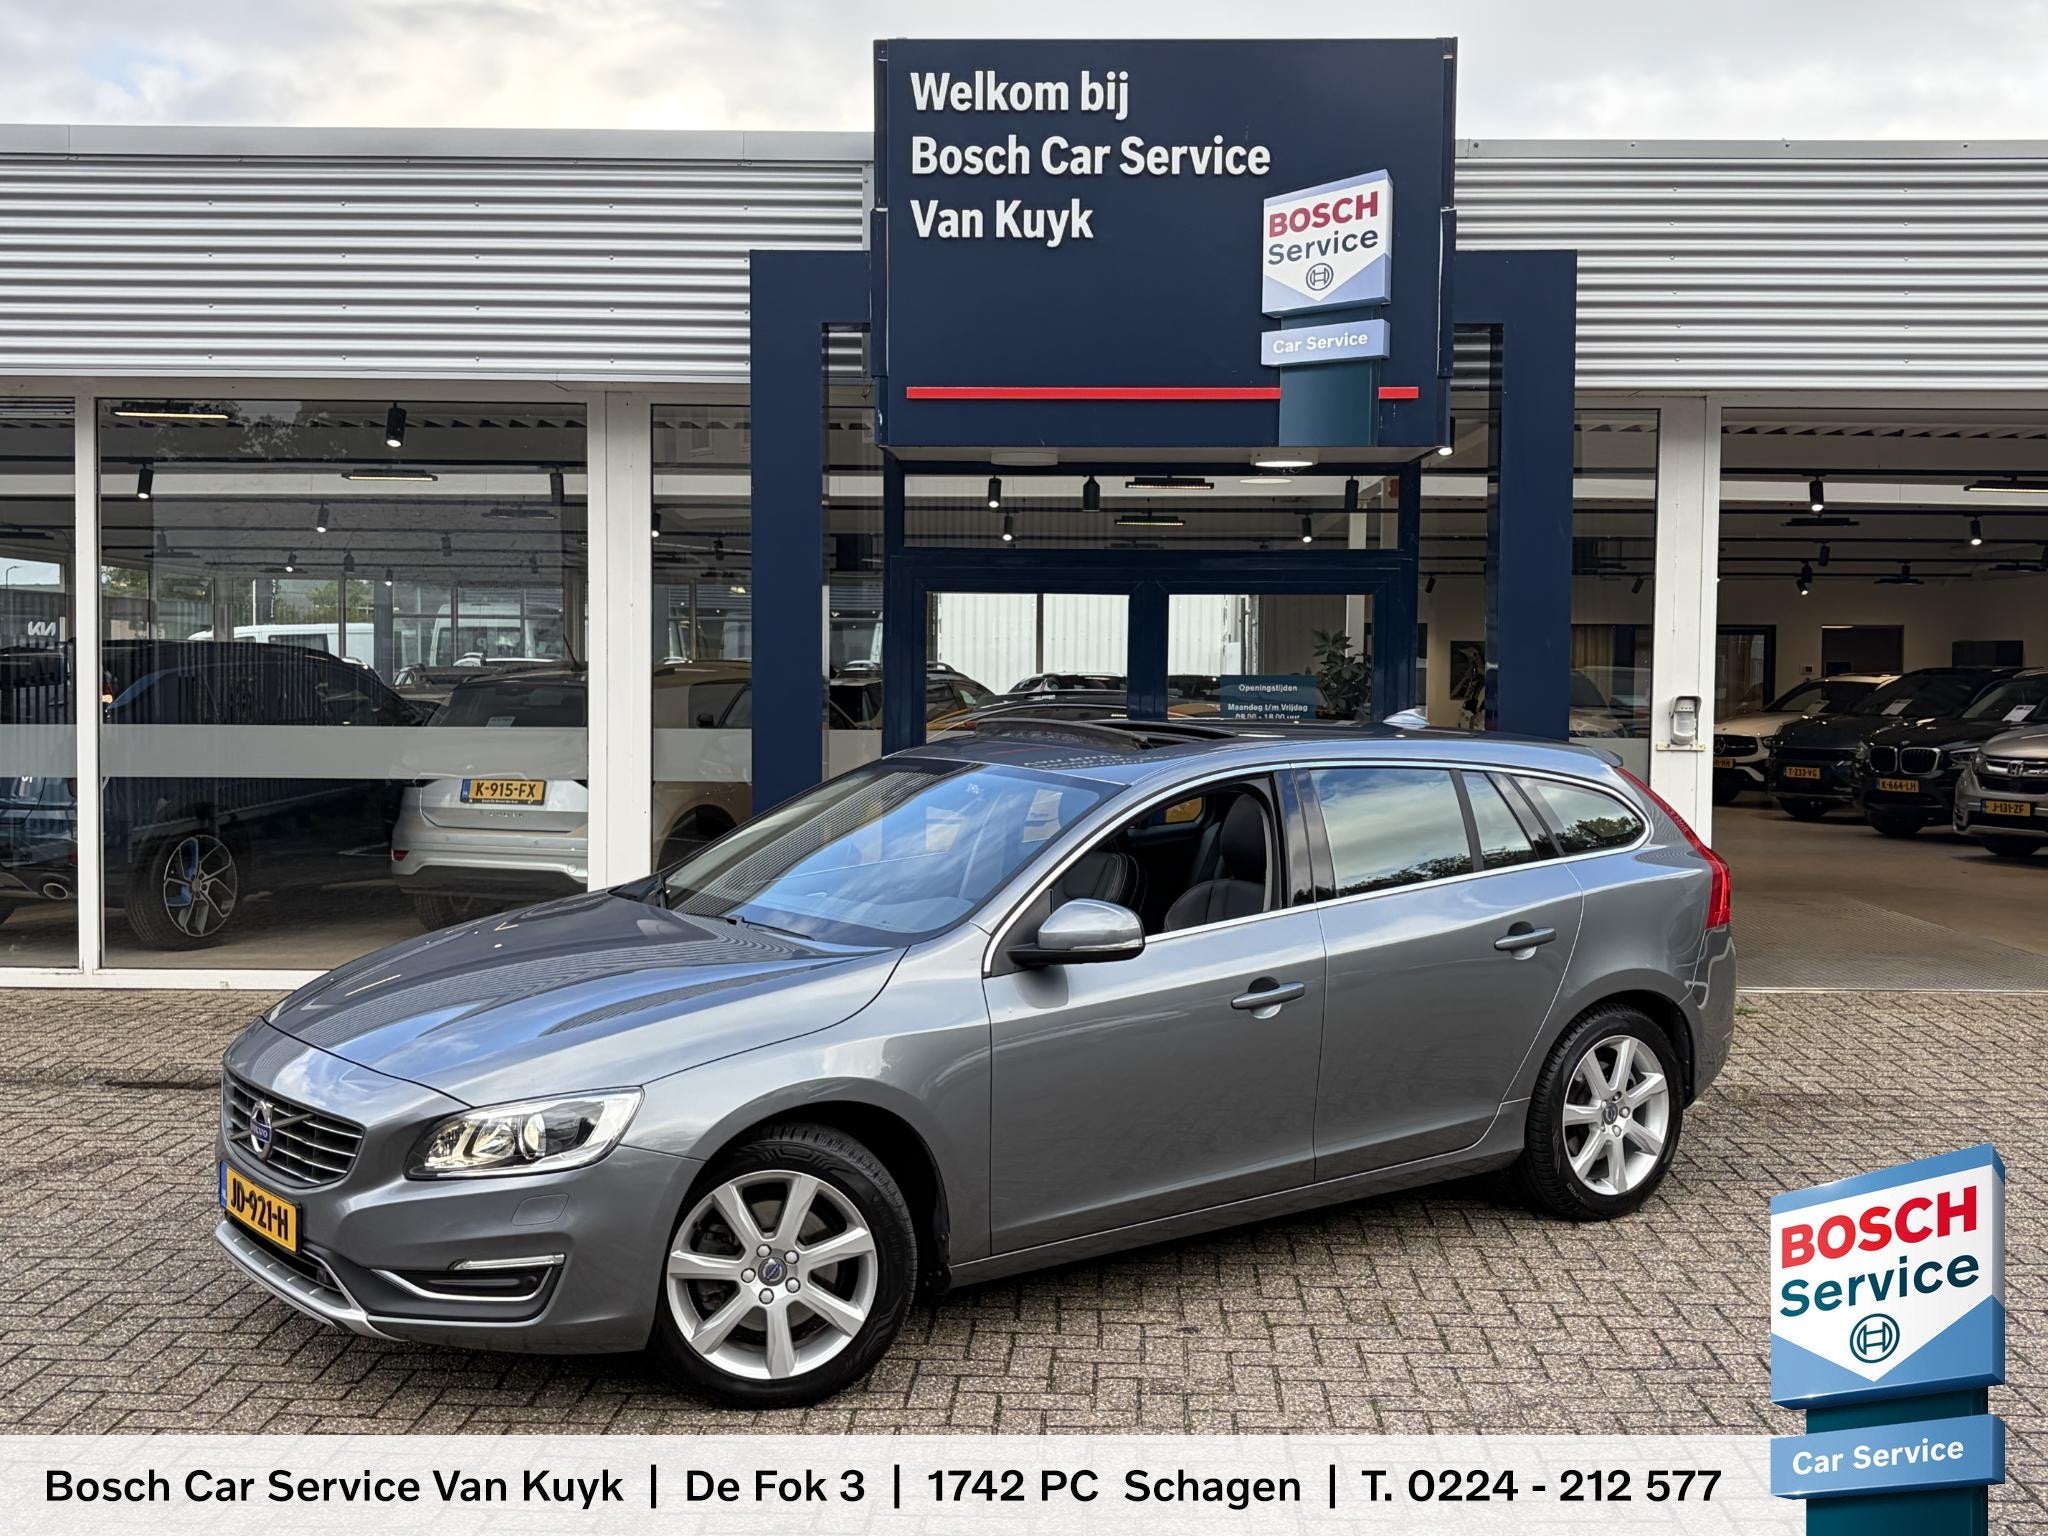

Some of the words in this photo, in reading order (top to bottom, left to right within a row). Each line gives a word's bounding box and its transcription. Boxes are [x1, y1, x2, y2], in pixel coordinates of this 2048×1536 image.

[910, 70, 1068, 112] Welkom
[1081, 70, 1128, 121] bij
[911, 134, 1029, 175] Bosch
[1042, 135, 1112, 175] Car
[1119, 134, 1271, 175] Service
[910, 199, 983, 239] Van
[995, 198, 1093, 247] Kuyk
[1269, 191, 1378, 237] BOSCH
[1268, 229, 1378, 265] Service
[1273, 340, 1300, 353] Car
[1306, 332, 1368, 349] Service
[1227, 703, 1263, 712] Maandag
[1264, 703, 1280, 711] t/m
[1280, 703, 1308, 712] Vrijdag
[1238, 684, 1298, 693] Openingstijden
[475, 782, 536, 798] K-915-FX
[231, 1177, 288, 1242] JD-921-H
